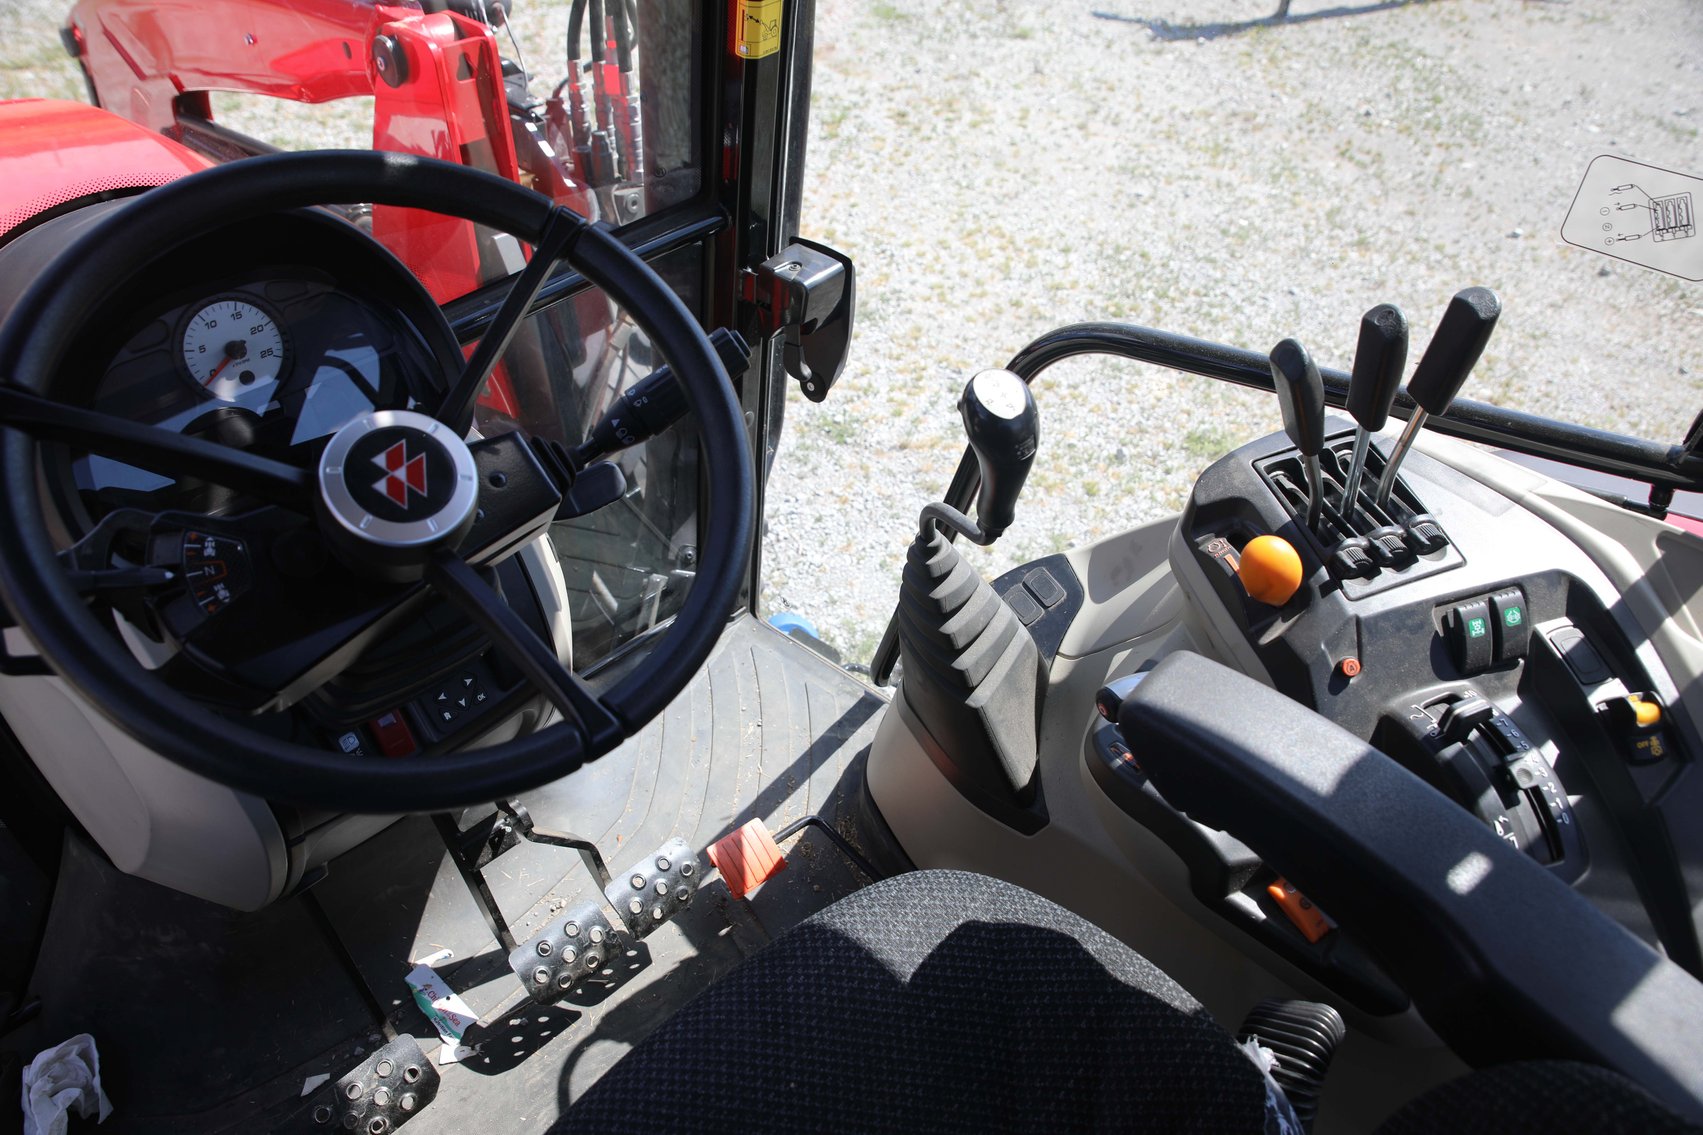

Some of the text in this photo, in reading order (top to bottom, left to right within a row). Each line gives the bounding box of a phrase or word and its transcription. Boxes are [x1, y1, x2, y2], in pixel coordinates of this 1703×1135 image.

[230, 311, 242, 320] 15
[205, 320, 217, 329] 10
[250, 324, 264, 335] 20
[198, 345, 206, 353] 5
[260, 348, 273, 358] 25
[204, 566, 215, 576] N
[1500, 719, 1509, 728] 7
[1511, 729, 1520, 738] 6
[1520, 741, 1529, 750] 5
[1636, 740, 1648, 749] OFF
[1539, 767, 1548, 777] 3
[1548, 783, 1557, 793] 2
[1556, 798, 1563, 809] 1
[1562, 813, 1570, 825] 0
[449, 1013, 461, 1026] Sea
